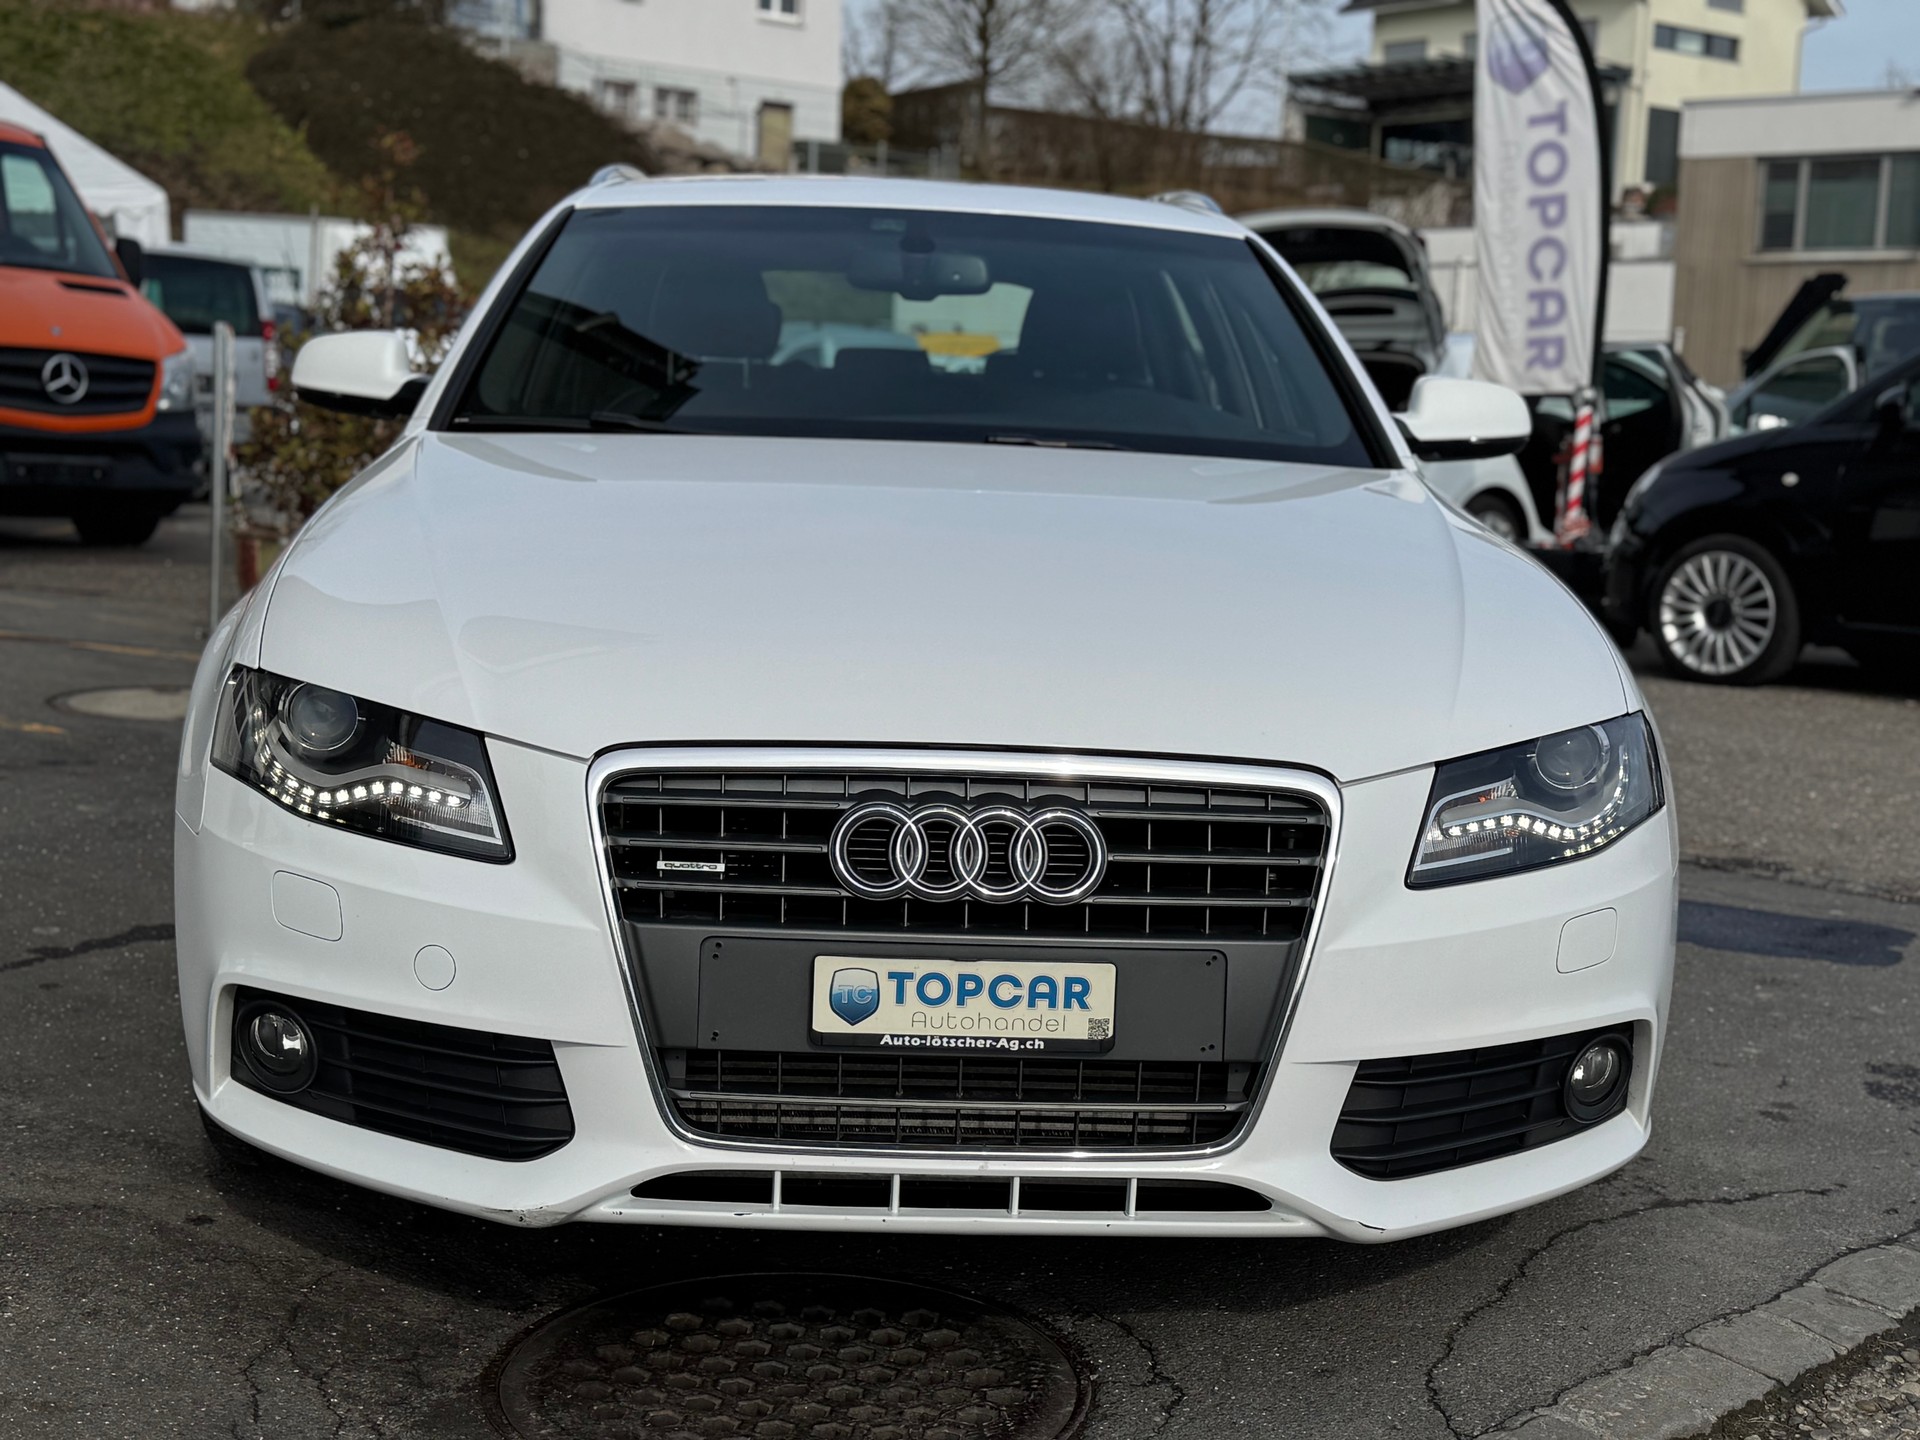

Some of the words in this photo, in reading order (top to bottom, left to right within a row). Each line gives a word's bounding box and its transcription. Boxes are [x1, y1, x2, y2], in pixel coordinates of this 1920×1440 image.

[1526, 100, 1569, 372] TOPCAR
[664, 862, 718, 871] quattro
[838, 985, 873, 1005] TC
[887, 971, 1091, 1011] TOPCAR
[911, 1011, 1067, 1033] Autohandel
[880, 1034, 1045, 1051] Auto-lötscher-Ag.ch
